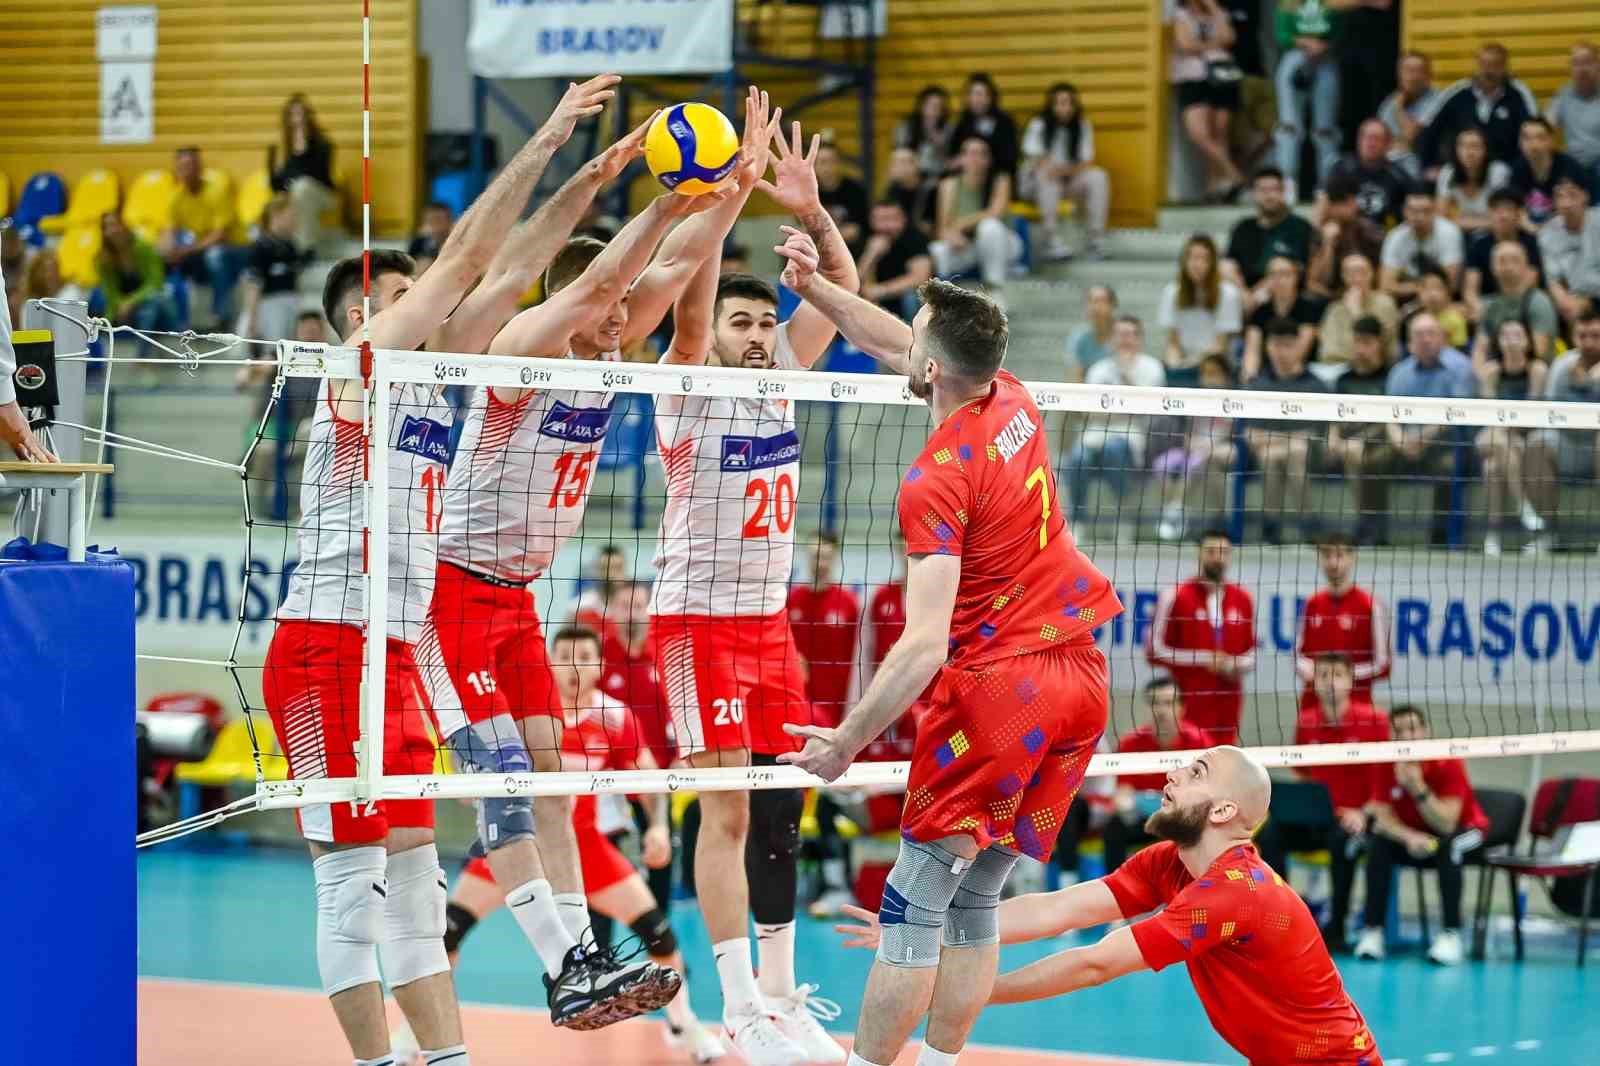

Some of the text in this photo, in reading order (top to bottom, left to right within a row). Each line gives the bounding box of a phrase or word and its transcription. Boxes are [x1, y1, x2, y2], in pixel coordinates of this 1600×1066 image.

[448, 367, 467, 377] CEV
[533, 371, 551, 382] FRV
[615, 375, 633, 385] CEV
[769, 383, 786, 393] CEV
[547, 450, 597, 509] 15
[742, 473, 796, 538] 20
[1025, 465, 1051, 551] 7
[1397, 599, 1600, 680] RAȘOV
[712, 697, 744, 727] 20
